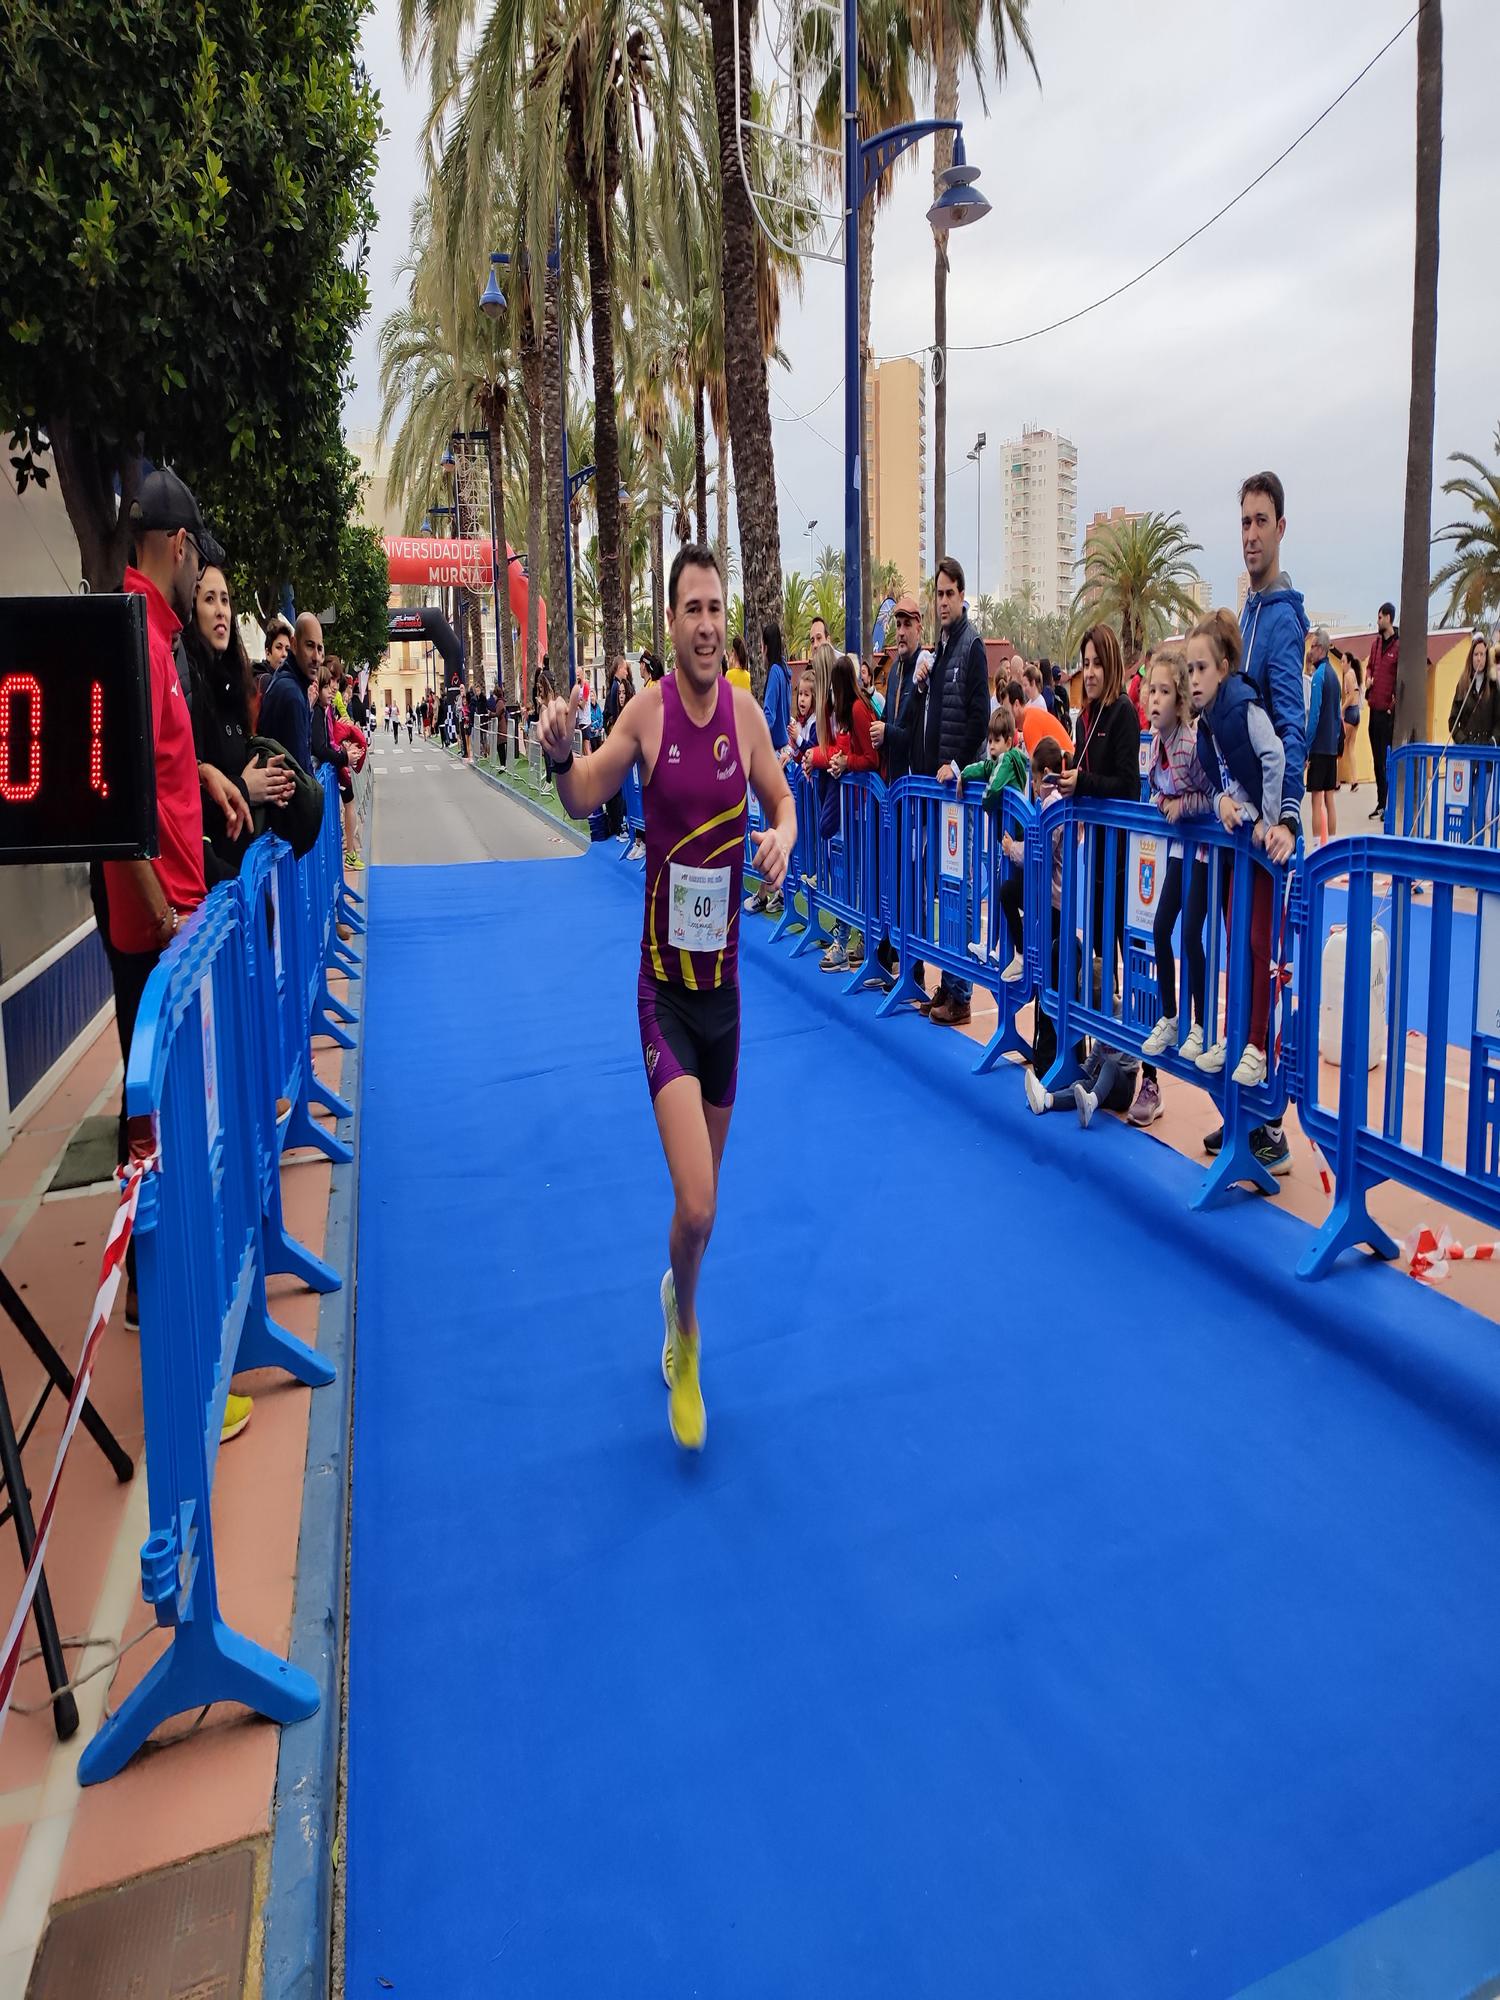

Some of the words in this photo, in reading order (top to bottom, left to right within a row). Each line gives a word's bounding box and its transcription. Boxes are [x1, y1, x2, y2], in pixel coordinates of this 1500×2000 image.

[382, 541, 460, 559] NIVERSIDAD
[464, 543, 480, 560] DE
[428, 566, 481, 583] MURCIA
[694, 896, 711, 918] 60
